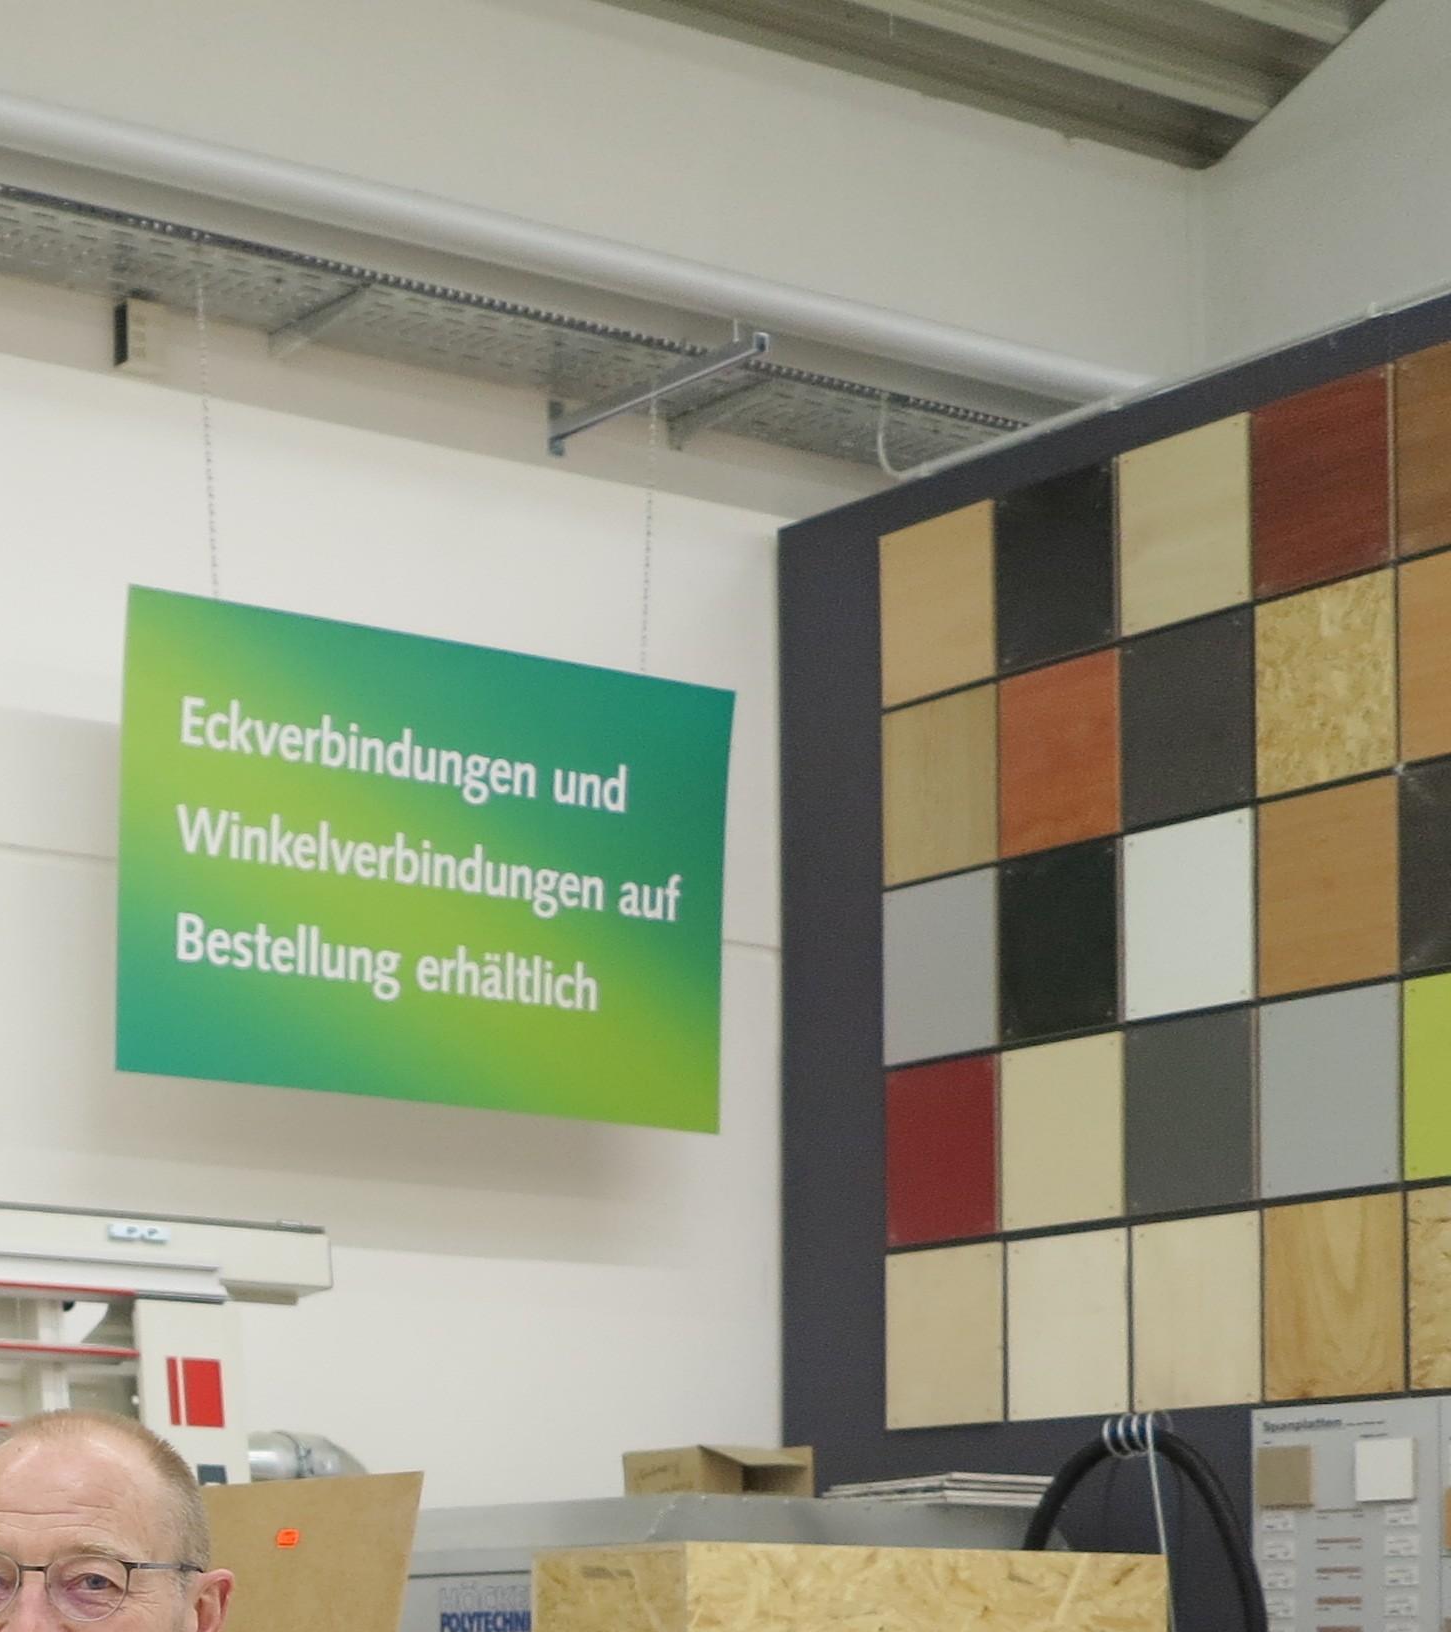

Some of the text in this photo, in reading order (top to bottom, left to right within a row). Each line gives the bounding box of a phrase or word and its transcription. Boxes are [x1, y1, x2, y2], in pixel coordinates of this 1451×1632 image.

[180, 695, 627, 814] Eckverbindungen und
[176, 803, 682, 922] Winkelverbindungen auf
[176, 912, 599, 1012] Bestellung erhältlich
